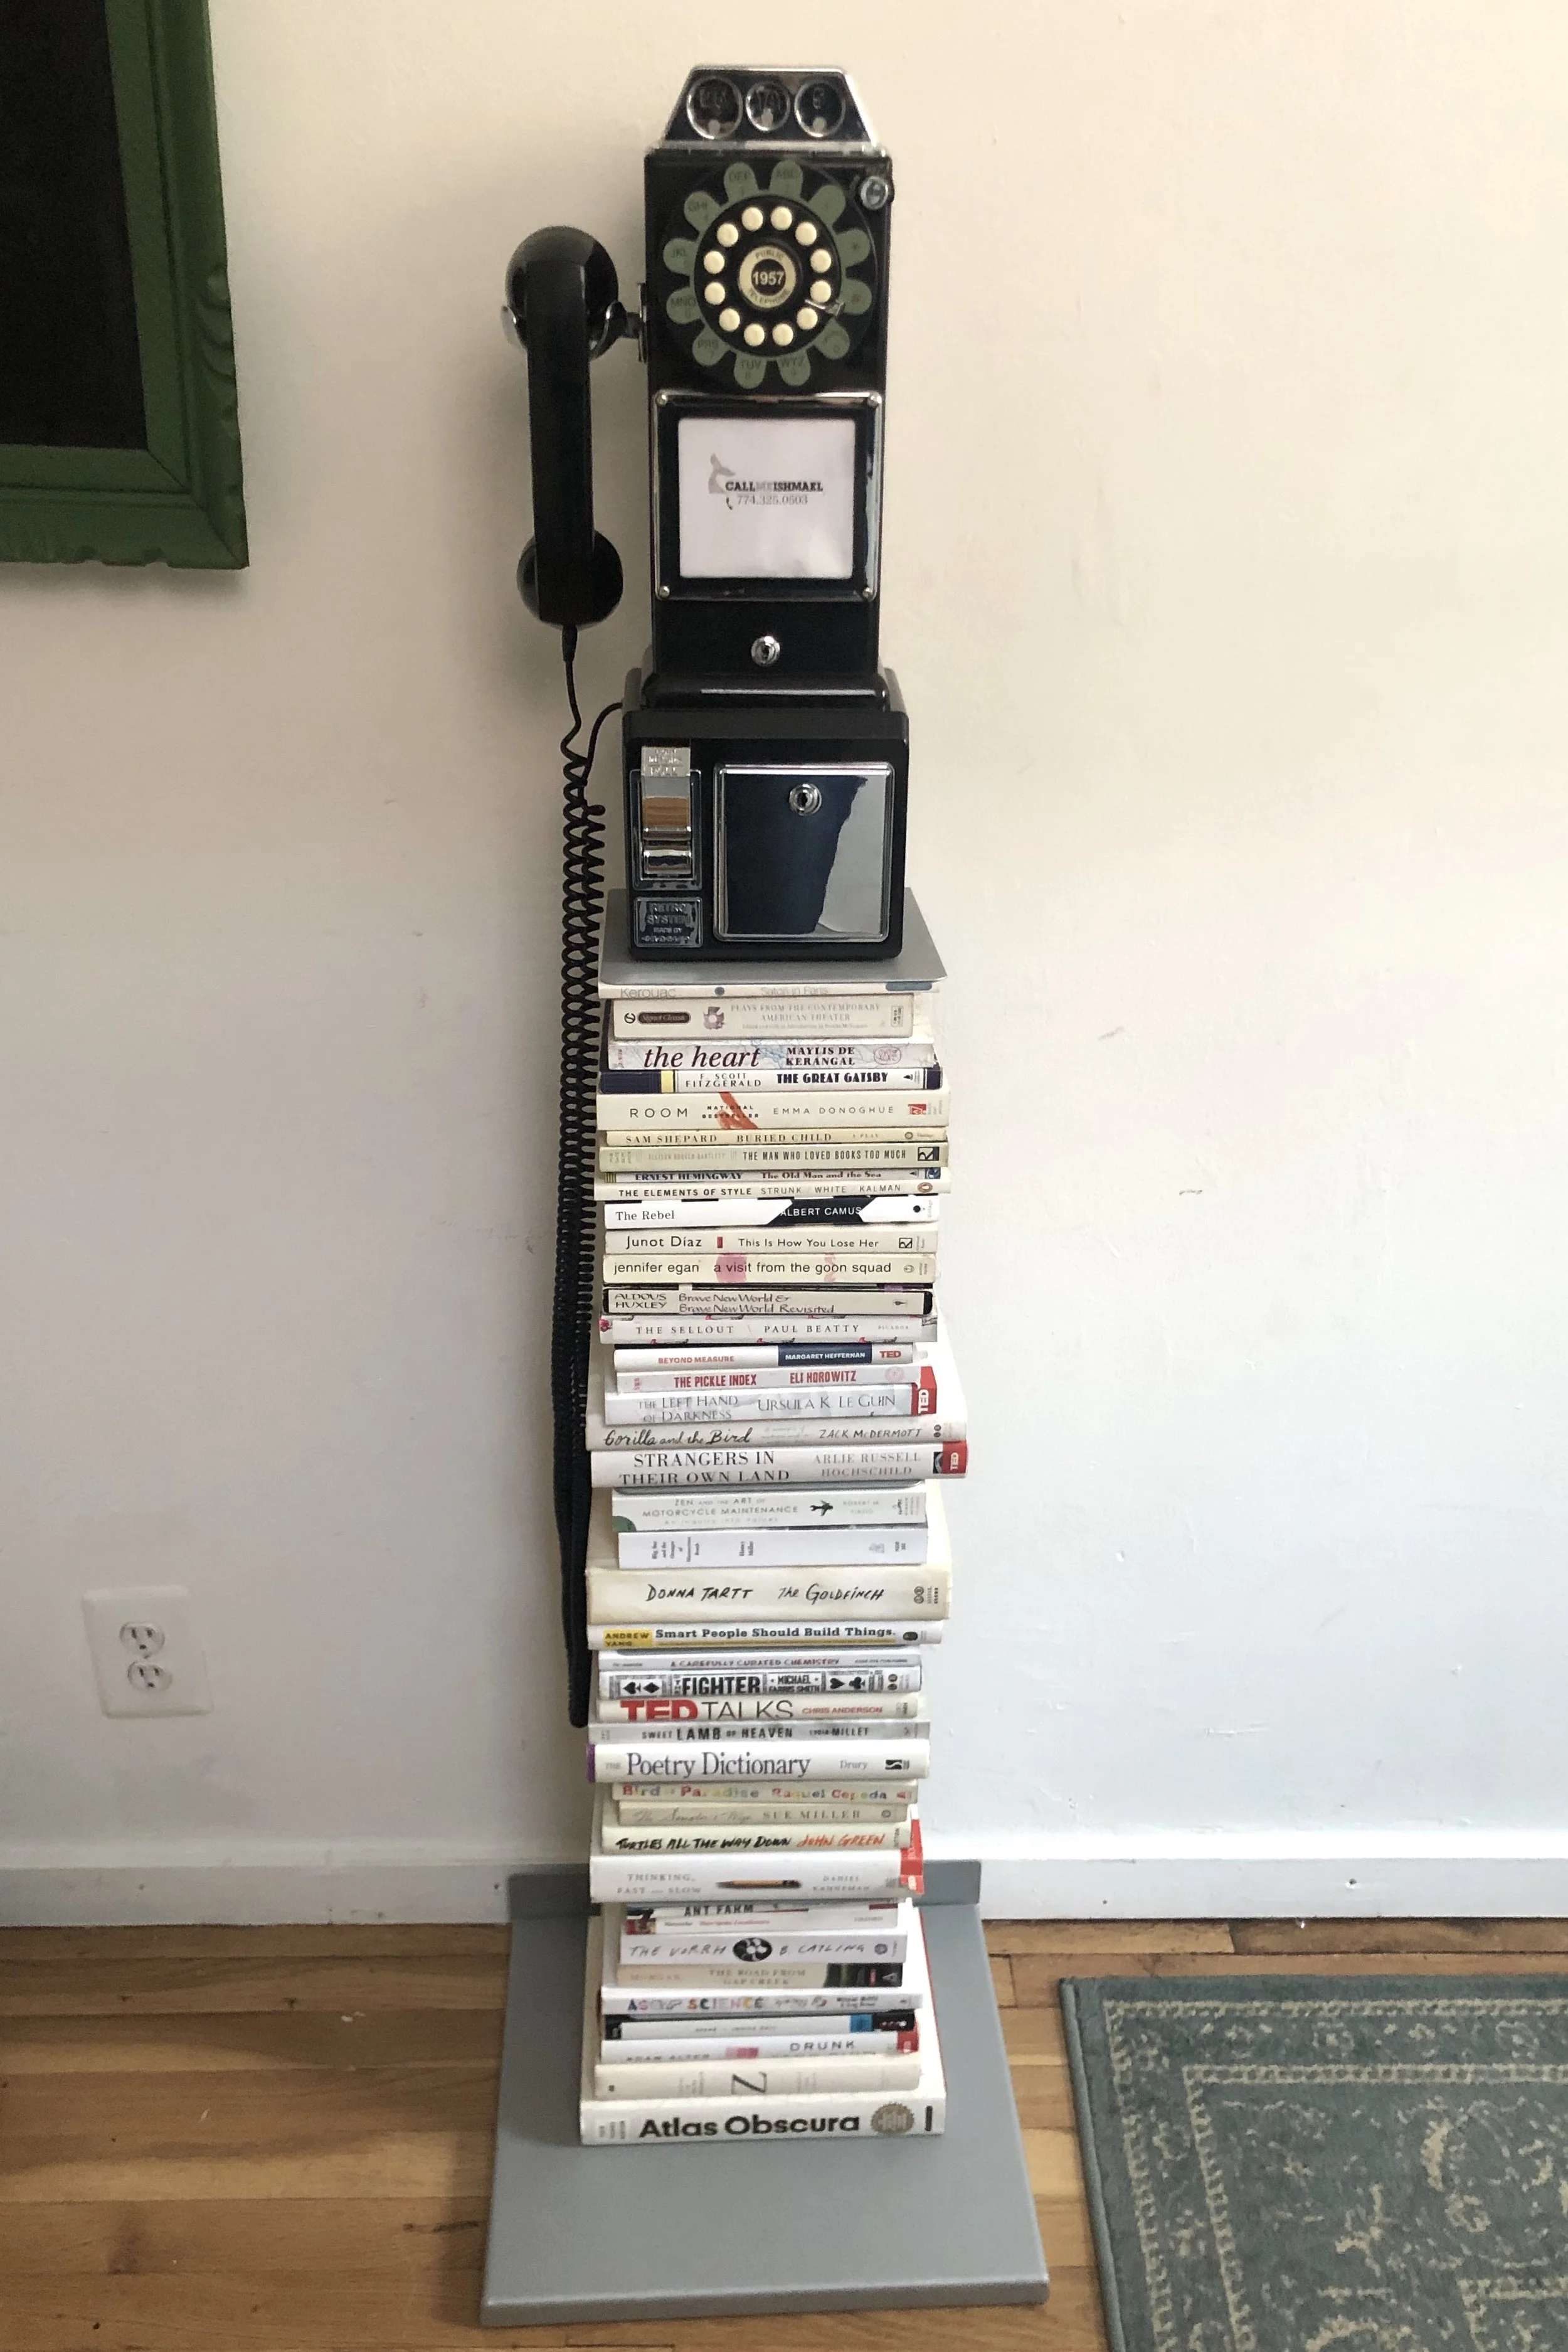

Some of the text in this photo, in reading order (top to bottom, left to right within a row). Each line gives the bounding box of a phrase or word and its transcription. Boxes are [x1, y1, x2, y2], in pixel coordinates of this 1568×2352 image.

[752, 271, 785, 285] 1957
[620, 987, 676, 998] Kerouac
[644, 1046, 683, 1067] the
[692, 1046, 760, 1067] heart
[786, 1058, 855, 1066] KERANGAL
[777, 1072, 888, 1083] THE GREAT GATSBY
[630, 1108, 687, 1118] ROOM
[737, 1134, 785, 1142] BURIED
[743, 1150, 906, 1161] THE MAN WHO LOVED BOOKS TOO MUCH
[761, 1187, 802, 1195] STRUNK
[616, 1211, 675, 1221] The Rebel
[824, 1207, 862, 1215] CAMUS
[626, 1235, 702, 1250] Junot Díaz
[739, 1238, 760, 1247] This
[614, 1263, 699, 1275] jennifer egan
[726, 1262, 751, 1272] visit
[757, 1262, 785, 1272] from
[791, 1263, 810, 1272] the
[815, 1264, 846, 1275] goon
[852, 1263, 891, 1274] squad
[679, 1293, 711, 1302] Brave
[738, 1293, 772, 1302] World
[680, 1304, 711, 1312] Brave
[739, 1304, 773, 1312] World
[780, 1304, 834, 1313] Revisited
[765, 1325, 798, 1333] PAUL
[674, 1374, 756, 1388] THE PICKLE INDEX
[790, 1371, 856, 1384] ELI HOROWITZ
[758, 1398, 813, 1411] URSULA
[918, 1389, 929, 1414] TED
[662, 1410, 731, 1422] DARKNESS
[604, 1430, 655, 1446] Gorilla
[660, 1431, 684, 1444] and
[688, 1430, 704, 1445] the
[706, 1427, 753, 1445] Bird
[819, 1429, 849, 1439] ZACK
[634, 1450, 775, 1468] STRANGERS IN
[861, 1452, 921, 1463] RUSSELL
[620, 1470, 789, 1485] THEIR OWN LAND
[822, 1467, 911, 1477] HOCHSCHILD
[642, 1506, 798, 1517] MOTORCYCLE MAINTENANCE
[646, 1584, 753, 1602] DONNA TARTT
[778, 1586, 799, 1599] The
[655, 1627, 840, 1639] Smart People Should Build
[737, 1659, 781, 1667] CURATED
[777, 1675, 811, 1684] MICHAEL
[682, 1676, 760, 1695] FIGHTER
[620, 1700, 793, 1721] TED TALKS
[642, 1727, 793, 1740] SWEET LAMB HEAVEN
[832, 1727, 869, 1736] MILLET
[627, 1752, 812, 1779] Poetry Dictionary
[840, 1760, 868, 1770] Drury
[800, 1811, 860, 1819] MILLER
[667, 1836, 792, 1849] ALL THE WAY DOWN
[684, 1905, 709, 1917] ANT
[630, 1946, 662, 1956] THE
[798, 1944, 864, 1953] CATLING
[790, 2041, 854, 2051] DRUNK
[639, 2116, 718, 2138] Atlas
[724, 2114, 859, 2136] Obscura
